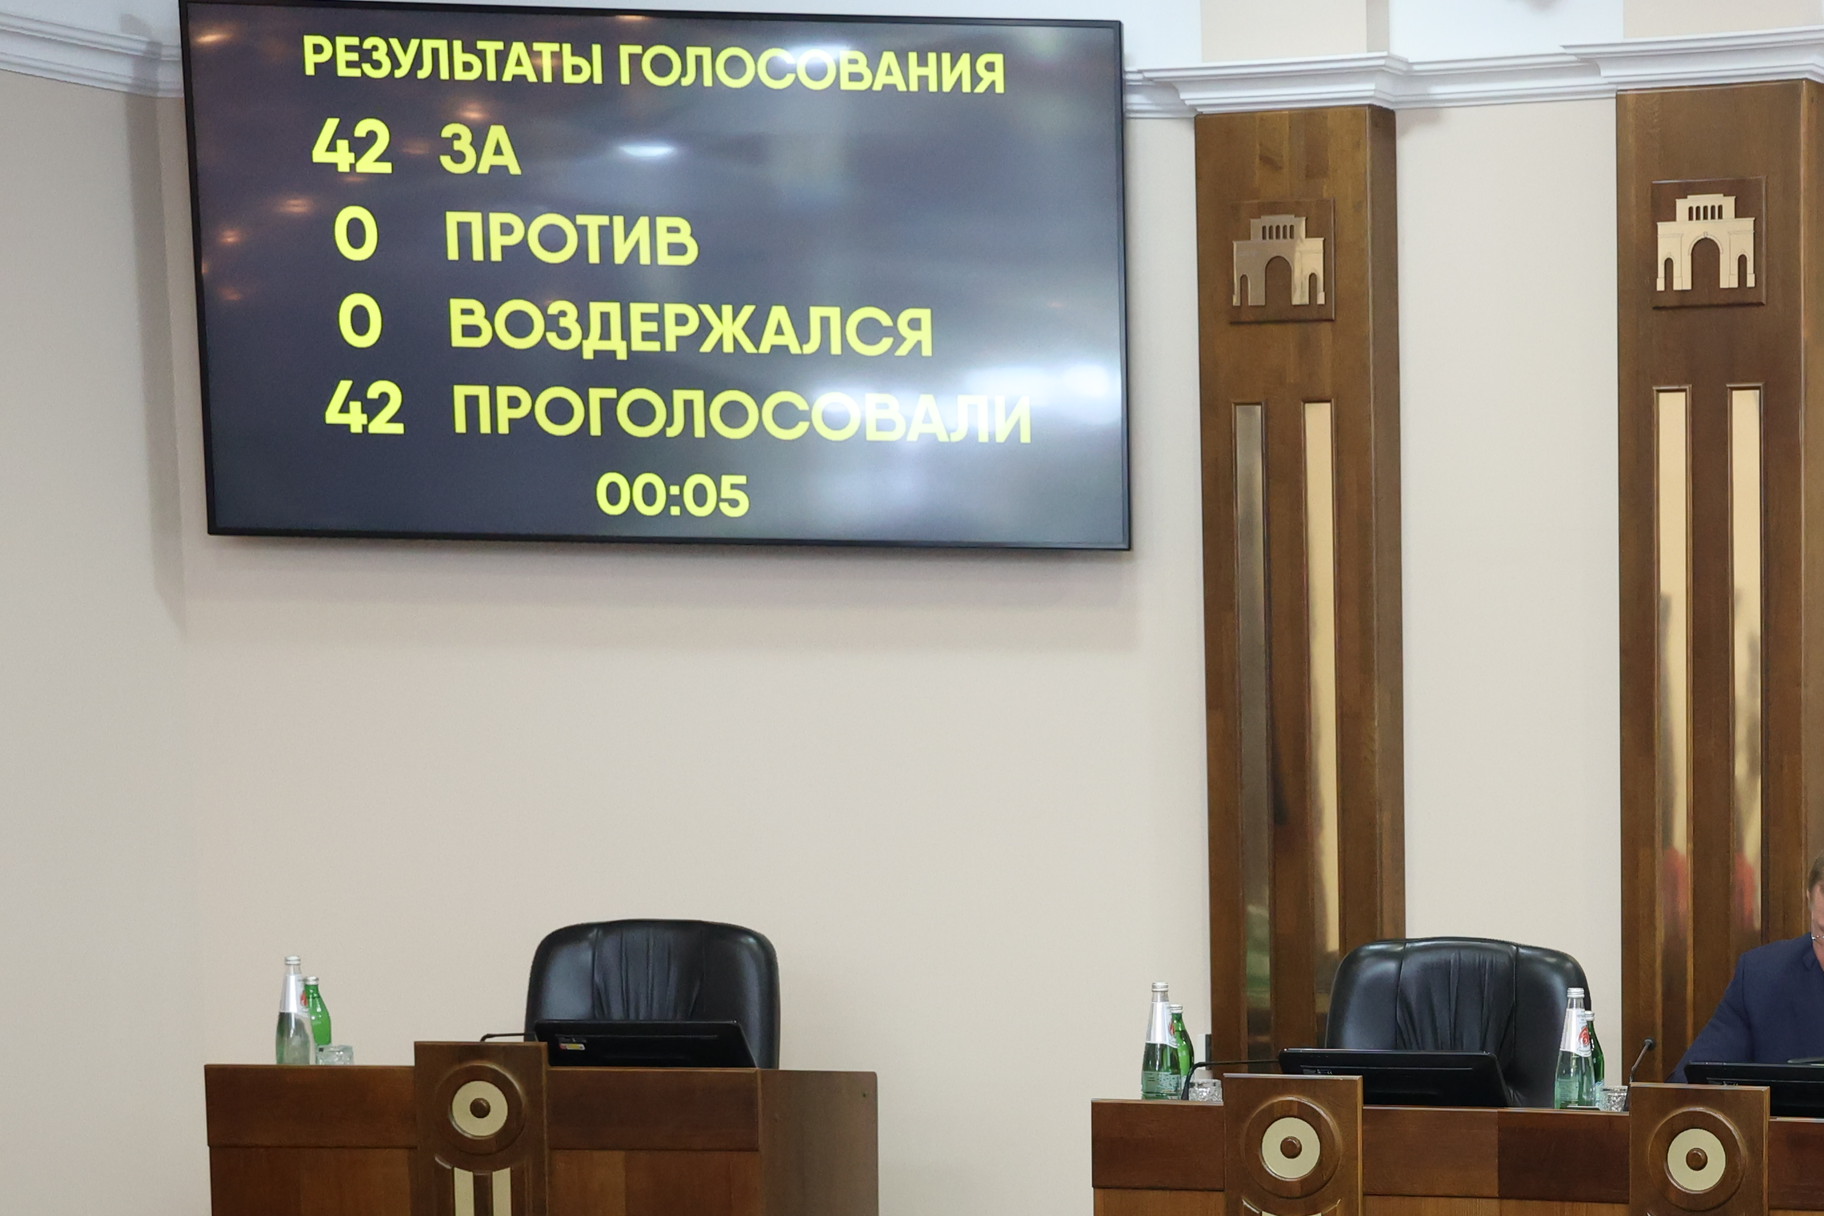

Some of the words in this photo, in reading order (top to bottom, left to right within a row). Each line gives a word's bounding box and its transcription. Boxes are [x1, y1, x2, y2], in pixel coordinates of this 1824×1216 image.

[303, 34, 603, 85] РЕЗУЛЬТАТЫ
[618, 44, 1006, 94] ГОЛОСОВАНИЯ
[311, 117, 393, 174] 42
[439, 122, 522, 176] ЗА
[334, 205, 378, 262] 0
[445, 210, 699, 266] ПРОТИВ
[338, 292, 383, 349] 0
[449, 297, 933, 361] ВОЗДЕРЖАЛСЯ
[324, 379, 405, 435] 42
[453, 384, 1033, 445] ПРОГОЛОСОВАЛИ
[595, 471, 750, 518] 00:05
